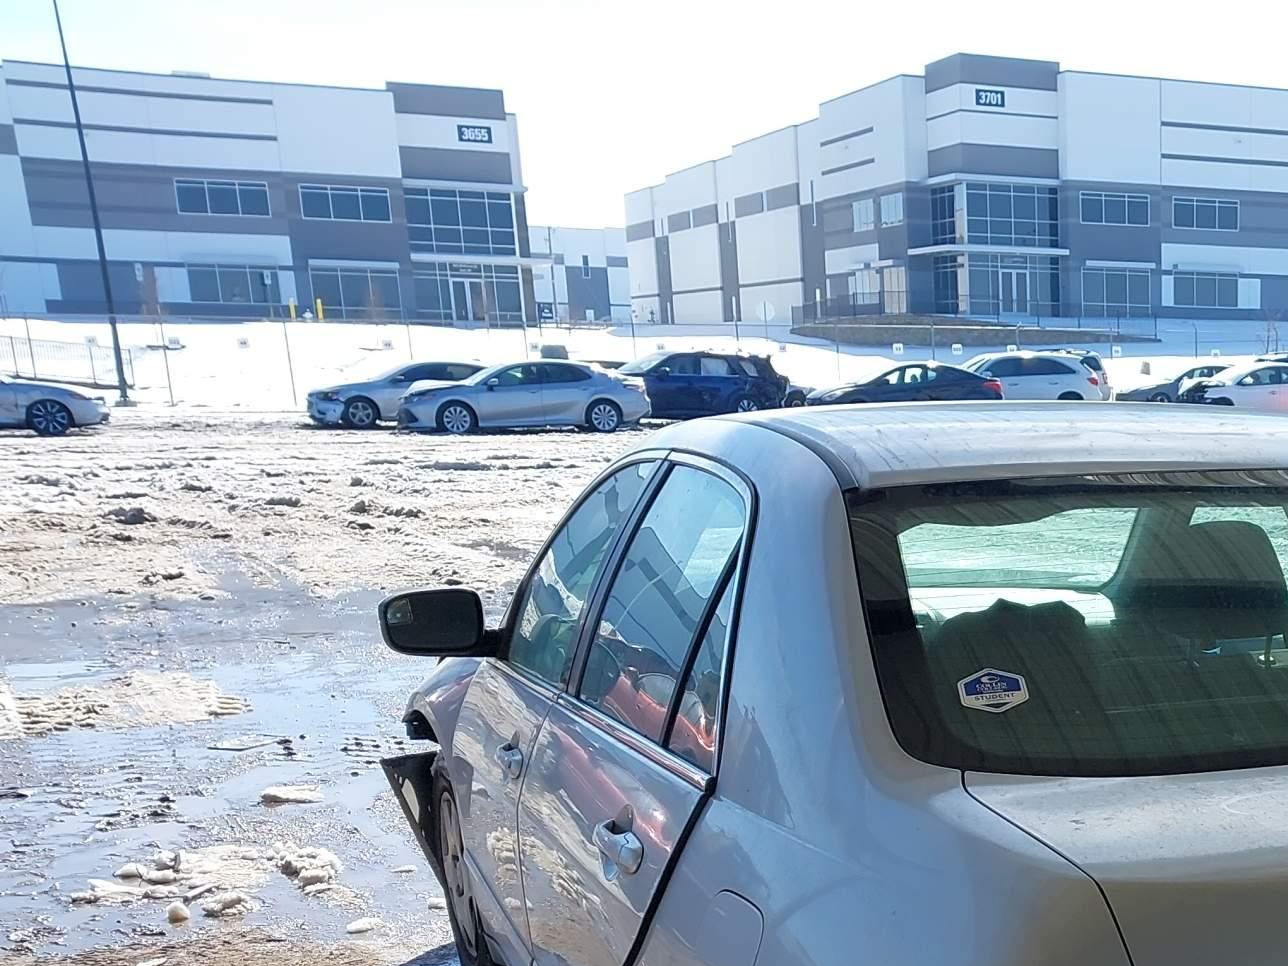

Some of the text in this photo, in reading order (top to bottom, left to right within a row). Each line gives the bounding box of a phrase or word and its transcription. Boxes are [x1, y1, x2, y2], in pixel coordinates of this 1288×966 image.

[978, 91, 1002, 105] 3701
[461, 126, 489, 141] 3655
[974, 692, 1016, 702] STUDENT
